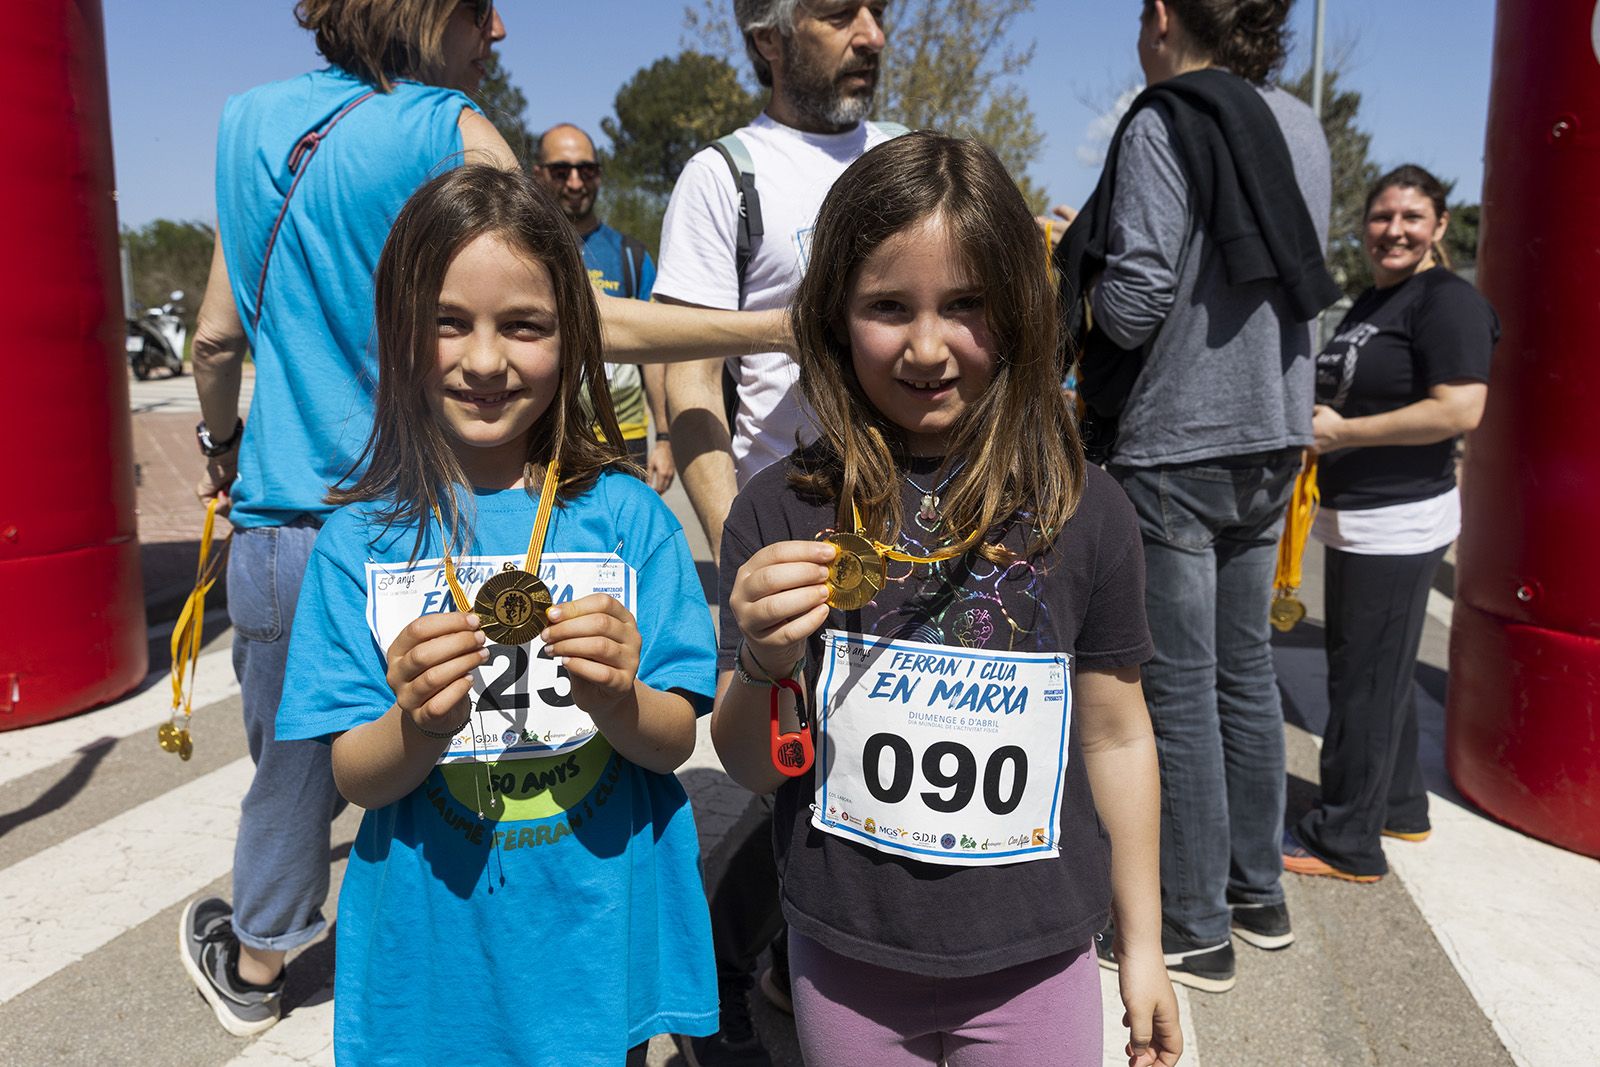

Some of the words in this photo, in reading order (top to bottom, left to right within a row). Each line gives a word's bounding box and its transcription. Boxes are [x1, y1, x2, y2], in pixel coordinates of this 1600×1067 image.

[396, 575, 415, 589] anys
[852, 647, 871, 662] anys
[890, 651, 962, 676] FERRAN
[966, 660, 975, 678] I
[980, 661, 1017, 681] CLUA
[868, 672, 921, 704] EN
[927, 679, 1028, 715] MARXA
[908, 711, 957, 725] DIUMENGE
[960, 717, 966, 726] 6
[521, 754, 581, 794] ANYS
[862, 732, 1028, 816] 090
[427, 786, 485, 845] JAUME
[879, 825, 898, 837] MGS
